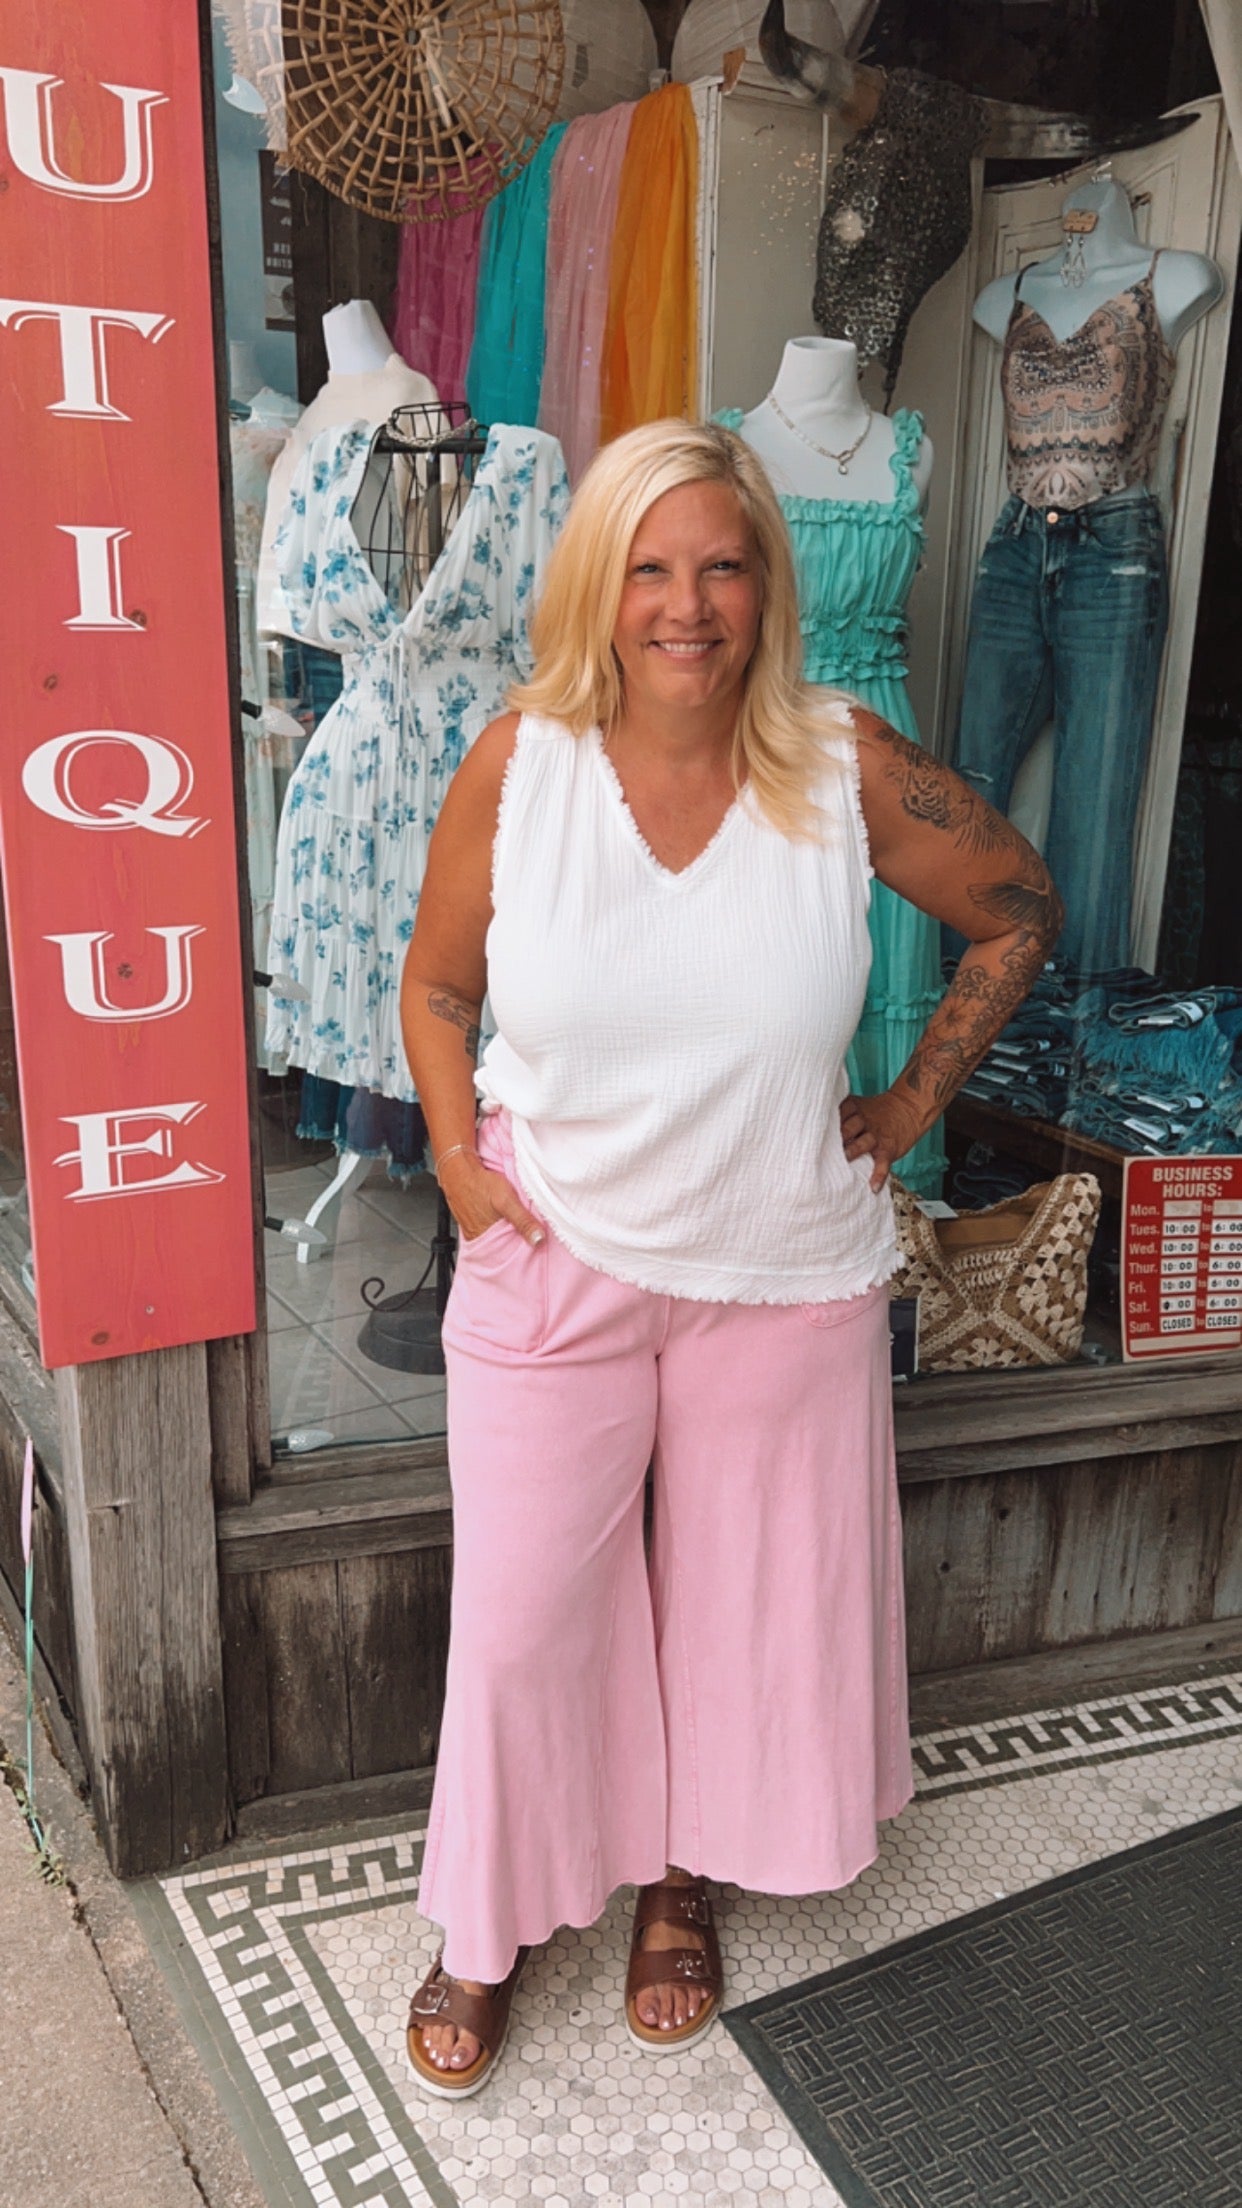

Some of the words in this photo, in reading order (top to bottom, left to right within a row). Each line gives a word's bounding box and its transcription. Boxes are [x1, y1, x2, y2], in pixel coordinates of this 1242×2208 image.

[0, 66, 227, 1204] UTIQUE
[1152, 1166, 1233, 1182] BUSINESS
[1162, 1183, 1223, 1198] HOURS:
[1130, 1204, 1160, 1217] Mon.
[1130, 1223, 1160, 1236] Tues.
[1129, 1242, 1158, 1255] Wed.
[1128, 1262, 1158, 1275] Thur.
[1127, 1281, 1146, 1294] Fri.
[1128, 1301, 1150, 1314] Sat.
[1128, 1320, 1154, 1334] Sun.
[1162, 1317, 1192, 1331] CLOSED
[1207, 1315, 1238, 1328] CLOSED
